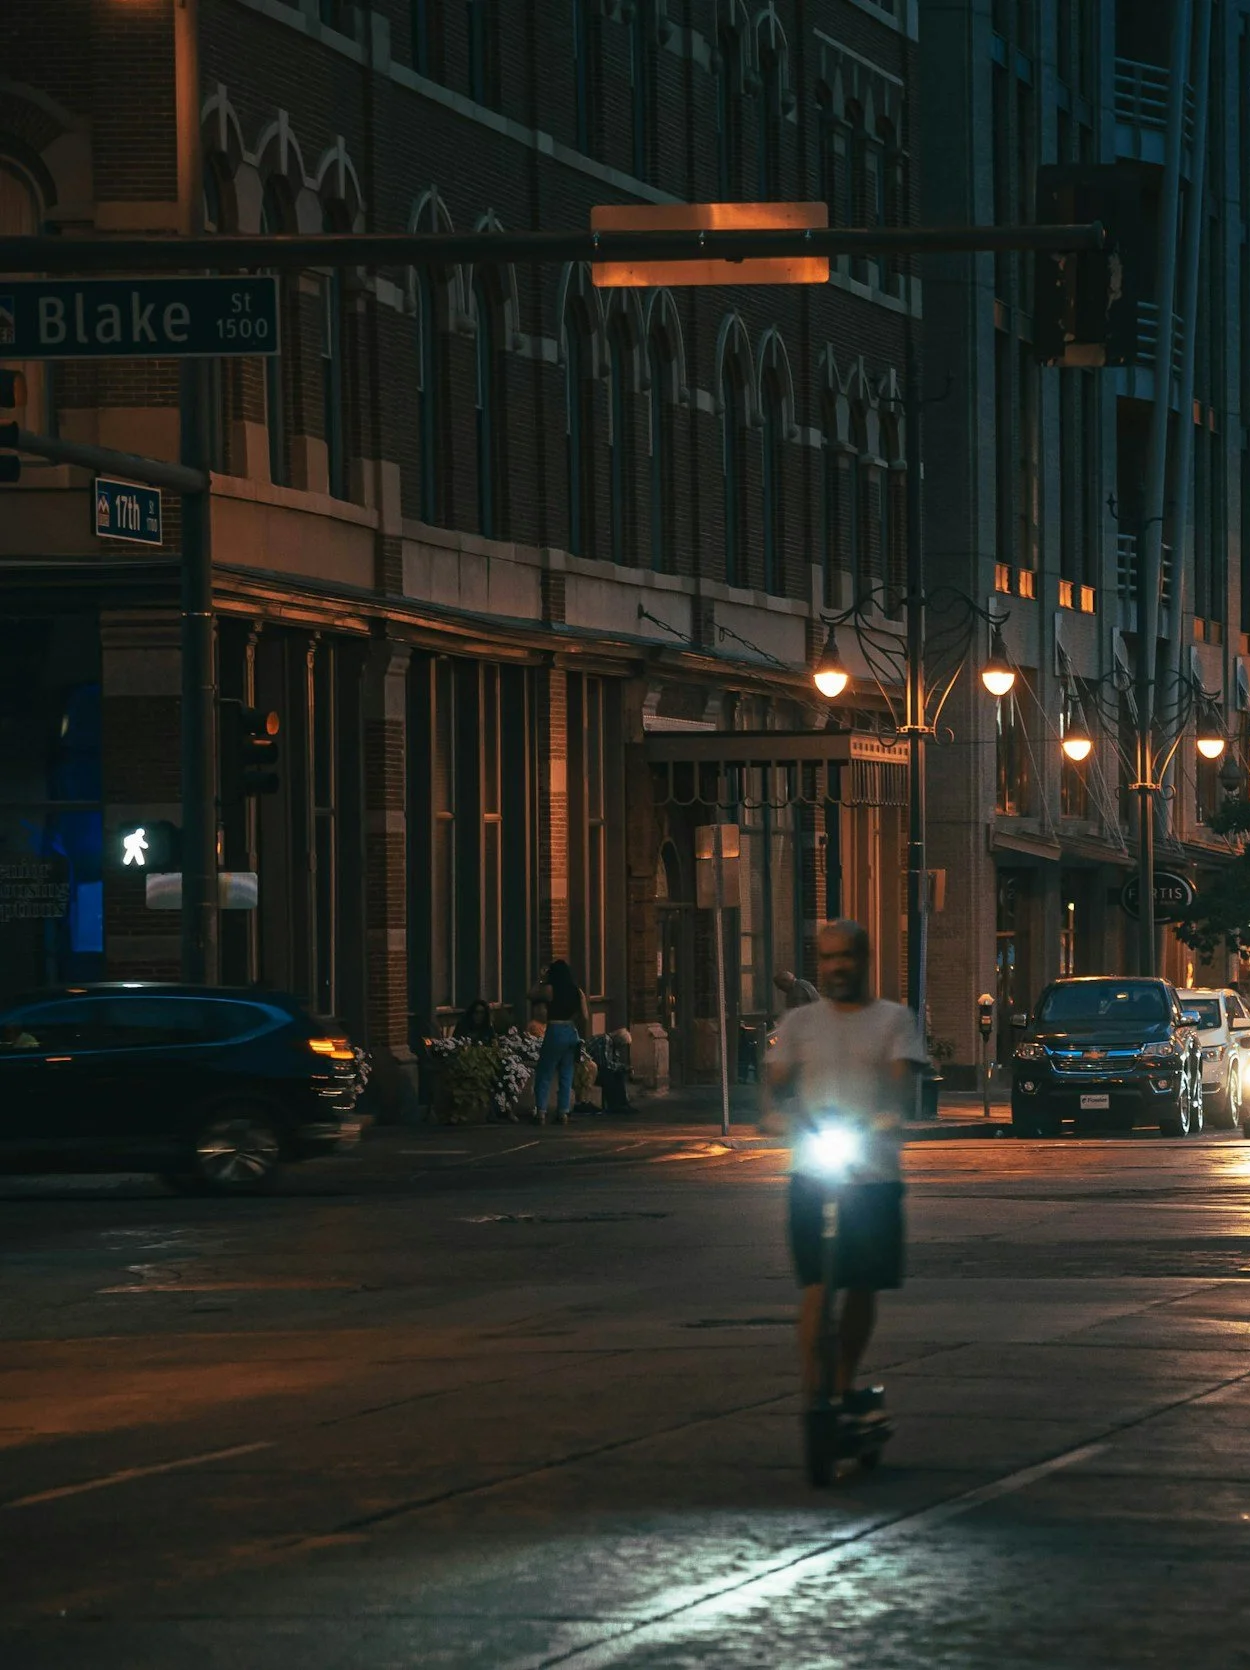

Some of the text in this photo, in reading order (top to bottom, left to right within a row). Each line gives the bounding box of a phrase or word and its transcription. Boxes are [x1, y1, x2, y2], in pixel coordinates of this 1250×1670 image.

[38, 291, 252, 344] Blake St
[216, 317, 268, 339] 1500
[115, 494, 141, 531] 17th
[1127, 887, 1183, 900] FRTIS
